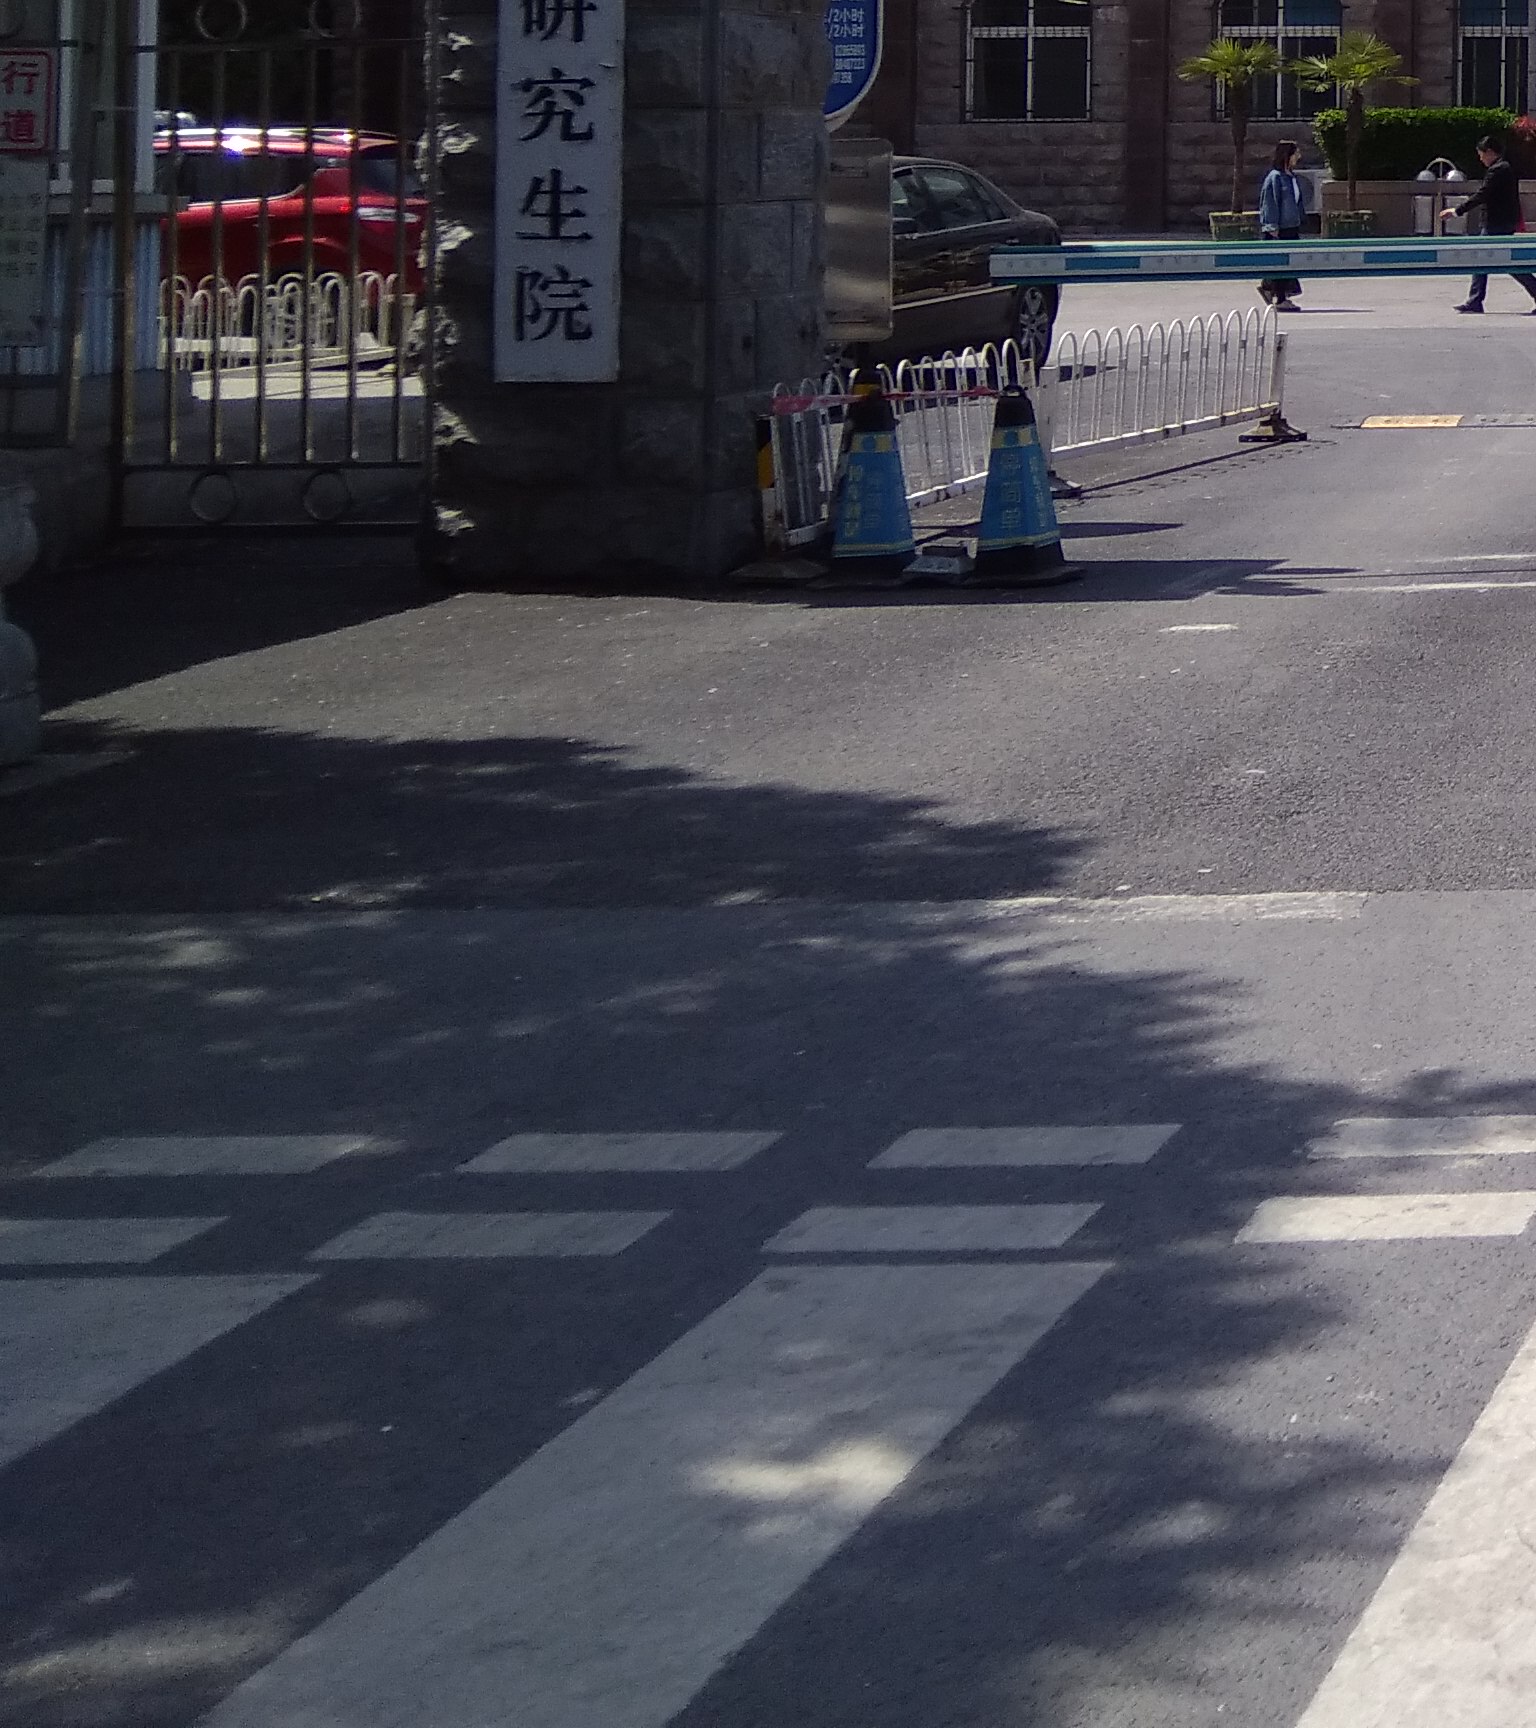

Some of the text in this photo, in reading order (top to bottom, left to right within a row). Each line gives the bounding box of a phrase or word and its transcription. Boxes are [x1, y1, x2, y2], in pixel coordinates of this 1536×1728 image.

[826, 8, 864, 22] /2小时
[827, 23, 864, 37] /2小时
[1, 61, 39, 95] 行
